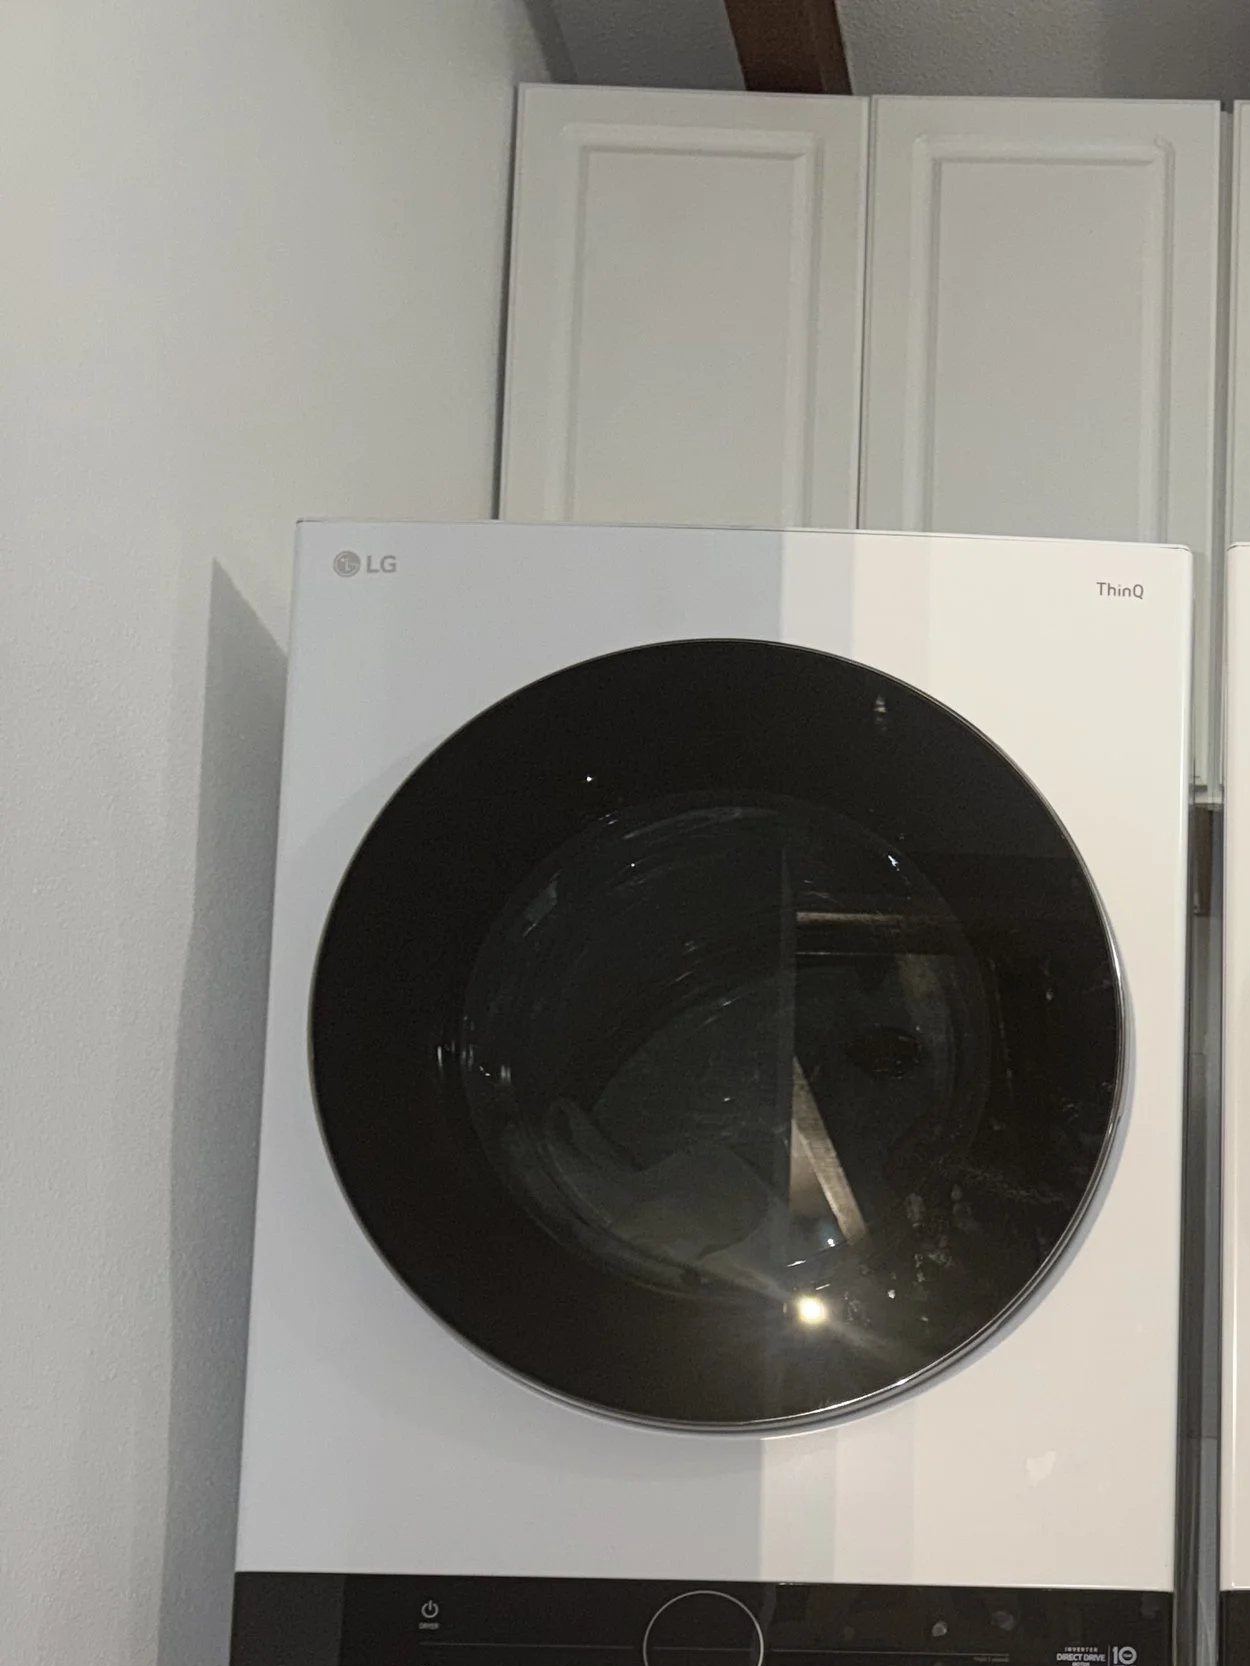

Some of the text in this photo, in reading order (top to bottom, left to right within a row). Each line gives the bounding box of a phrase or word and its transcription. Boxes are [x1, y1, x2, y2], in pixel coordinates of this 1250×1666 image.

[366, 555, 397, 573] LG
[1096, 582, 1144, 600] ThinQ
[1056, 1653, 1107, 1662] DIRECT DRIVE
[1112, 1646, 1137, 1665] 10
